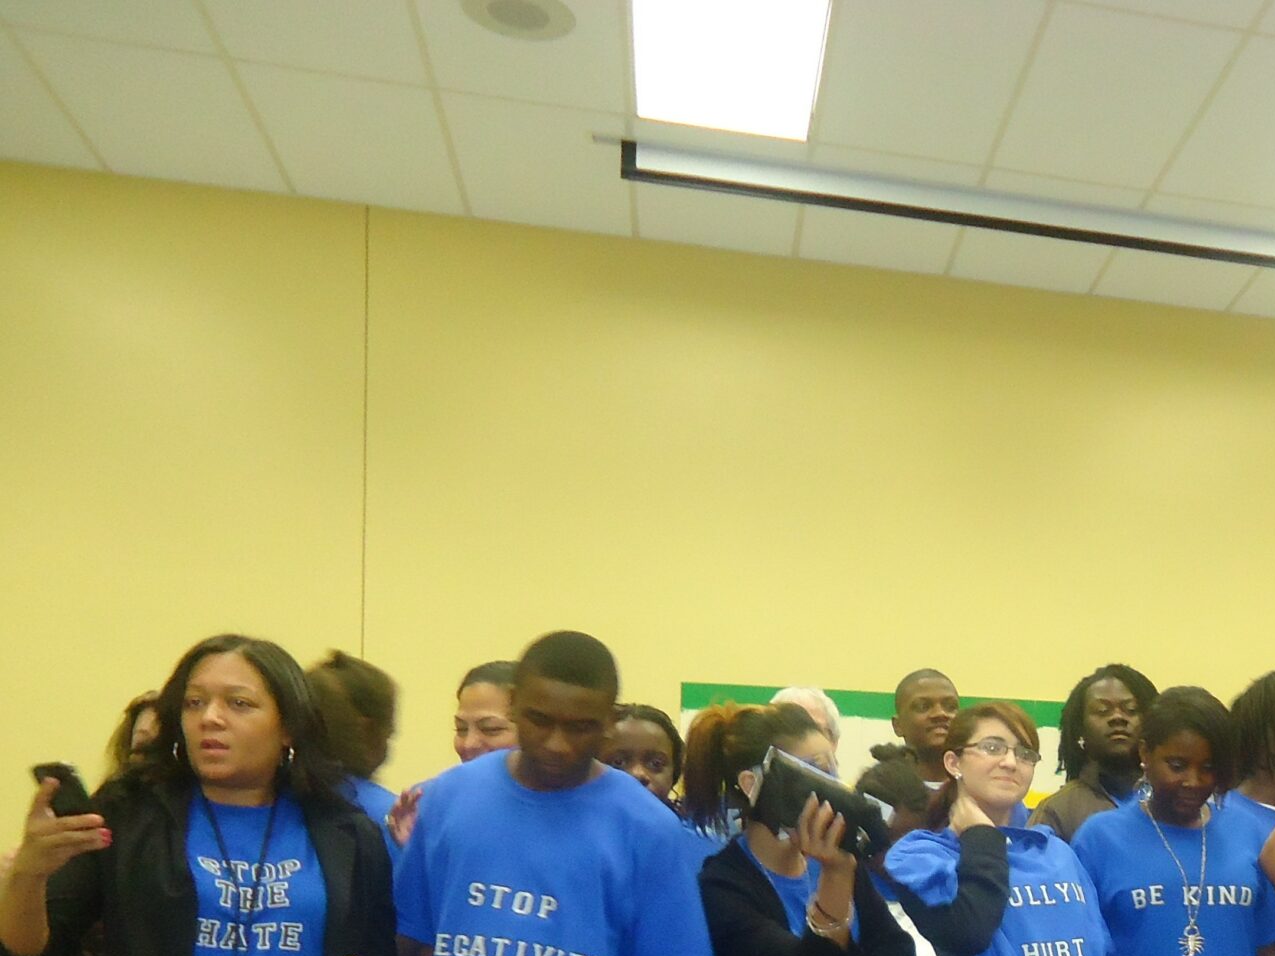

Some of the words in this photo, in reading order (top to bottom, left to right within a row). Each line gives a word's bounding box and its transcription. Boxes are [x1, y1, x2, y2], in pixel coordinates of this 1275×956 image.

[197, 855, 302, 883] STOP
[215, 879, 291, 913] THE
[467, 882, 559, 920] STOP
[1131, 885, 1166, 910] BE
[1182, 885, 1253, 907] KIND
[195, 917, 304, 952] HATE
